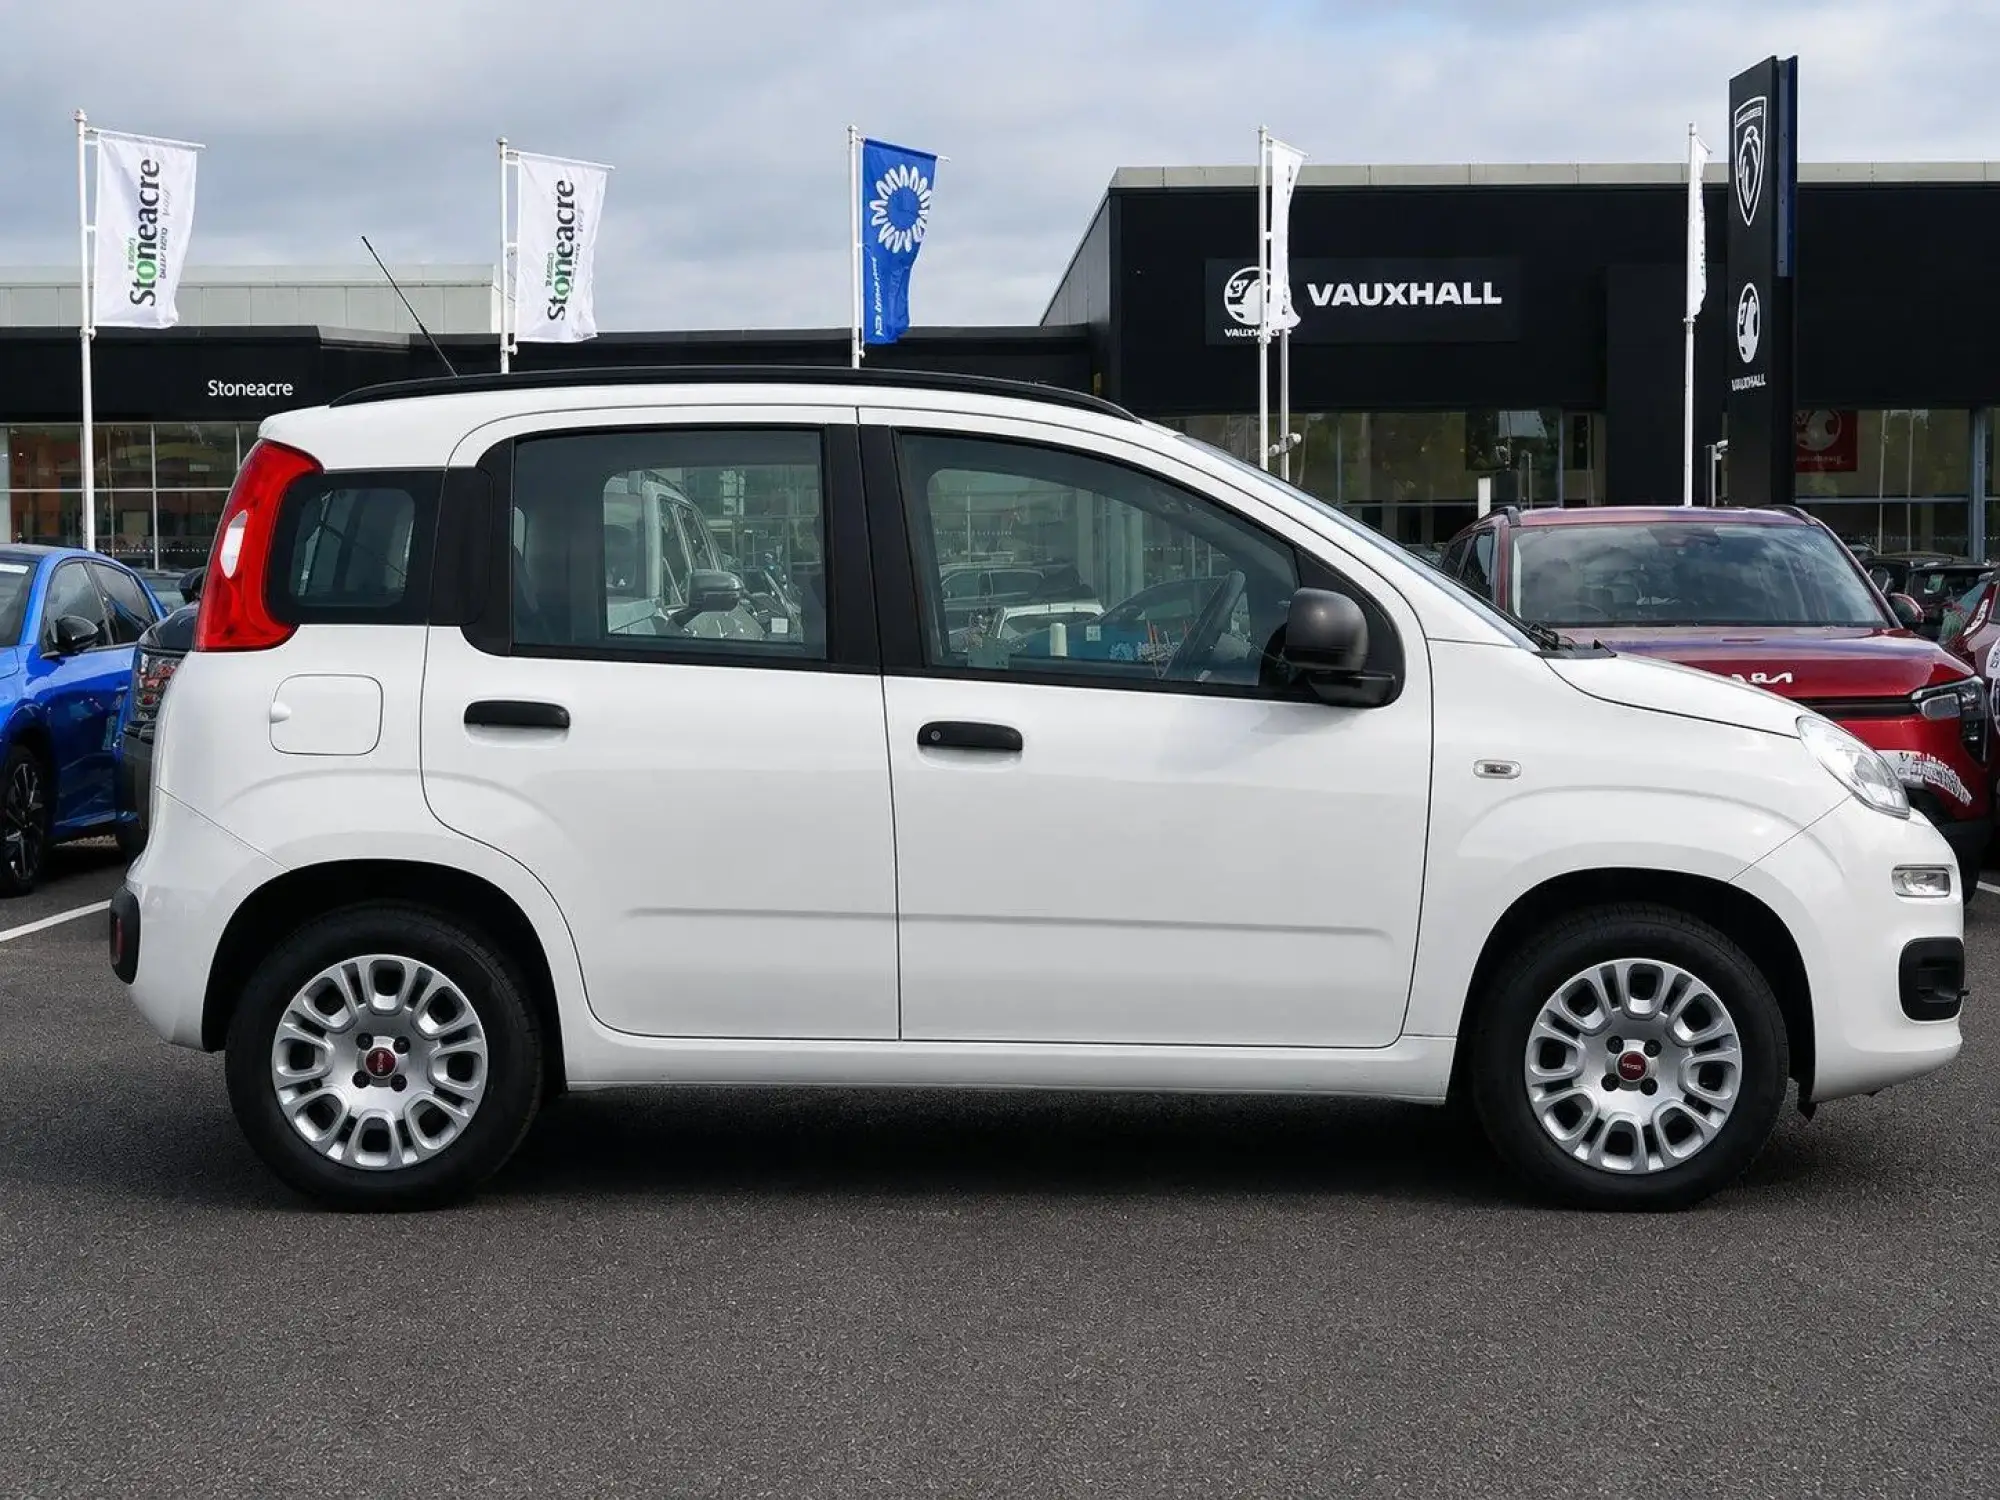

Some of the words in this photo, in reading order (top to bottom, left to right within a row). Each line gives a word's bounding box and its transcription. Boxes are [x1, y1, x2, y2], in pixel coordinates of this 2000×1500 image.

[129, 158, 160, 307] Stoneacre
[547, 179, 575, 322] Stoneacre
[1306, 281, 1503, 307] VAUXHALL
[207, 379, 294, 397] Stoneacre
